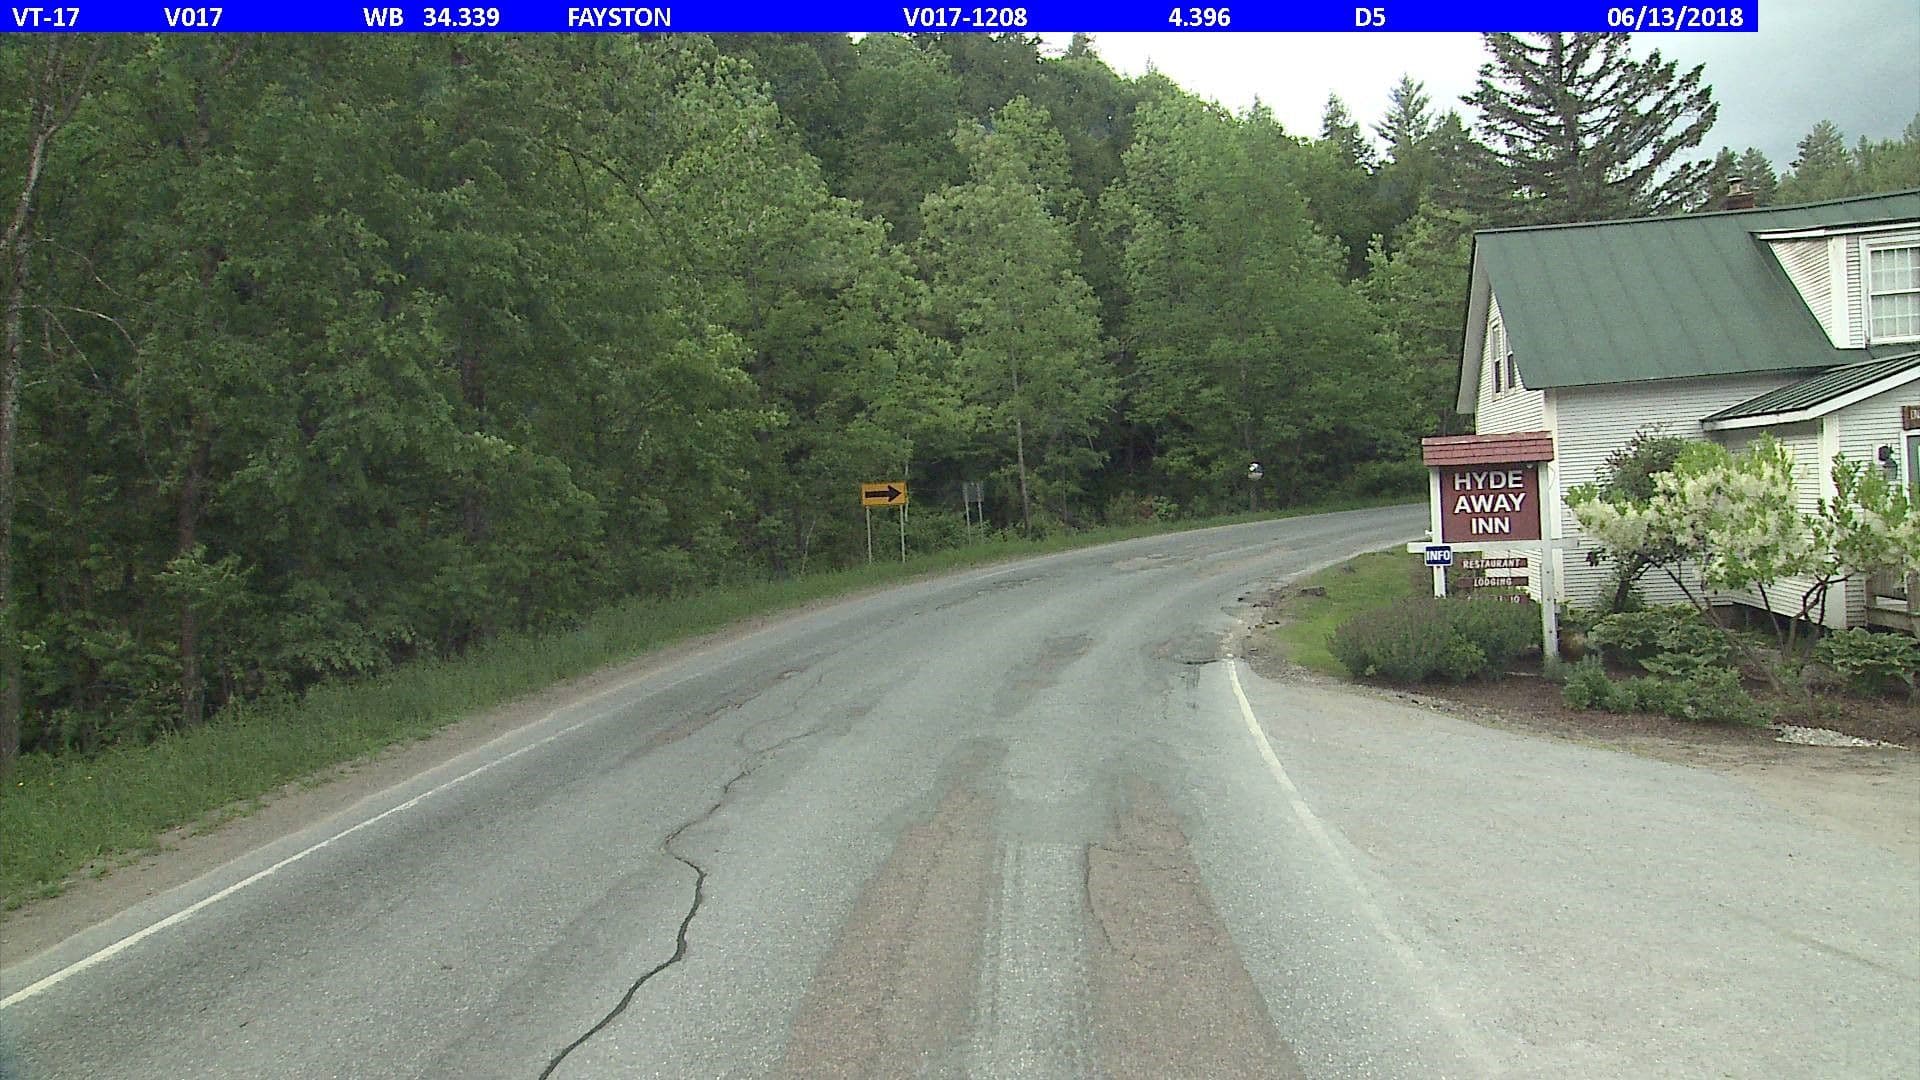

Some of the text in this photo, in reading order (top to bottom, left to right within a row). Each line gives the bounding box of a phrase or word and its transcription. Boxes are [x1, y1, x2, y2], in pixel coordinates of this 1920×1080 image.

[1454, 470, 1524, 491] HYDE
[1453, 493, 1527, 514] AWAY
[1471, 516, 1510, 535] INN
[1426, 550, 1451, 561] INFO
[1462, 559, 1521, 569] RESTAURANT
[1474, 577, 1513, 587] LODGING
